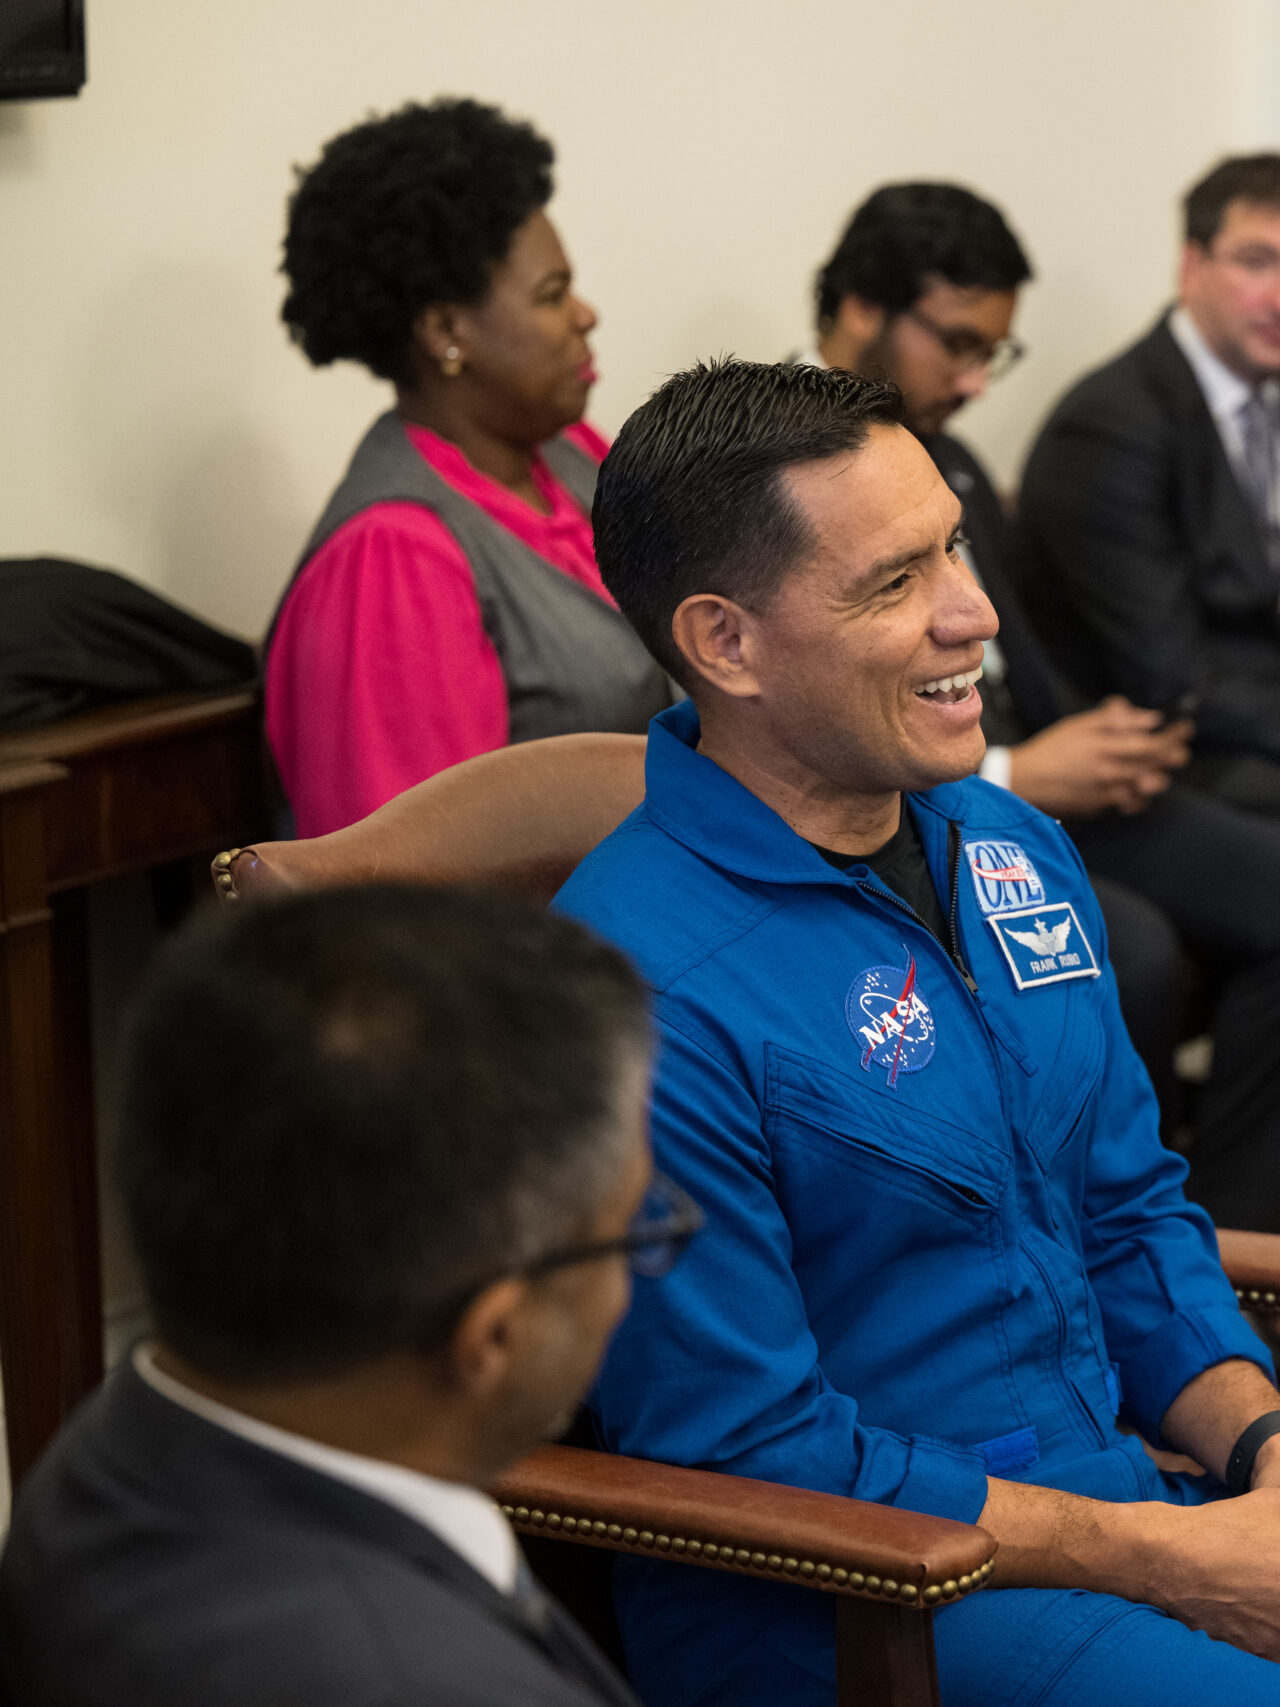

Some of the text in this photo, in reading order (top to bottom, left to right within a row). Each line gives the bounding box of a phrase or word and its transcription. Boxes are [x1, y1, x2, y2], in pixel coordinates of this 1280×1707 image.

[975, 844, 1042, 909] ONE
[1030, 952, 1081, 974] FRANK RUBIO
[859, 991, 929, 1050] NASA
